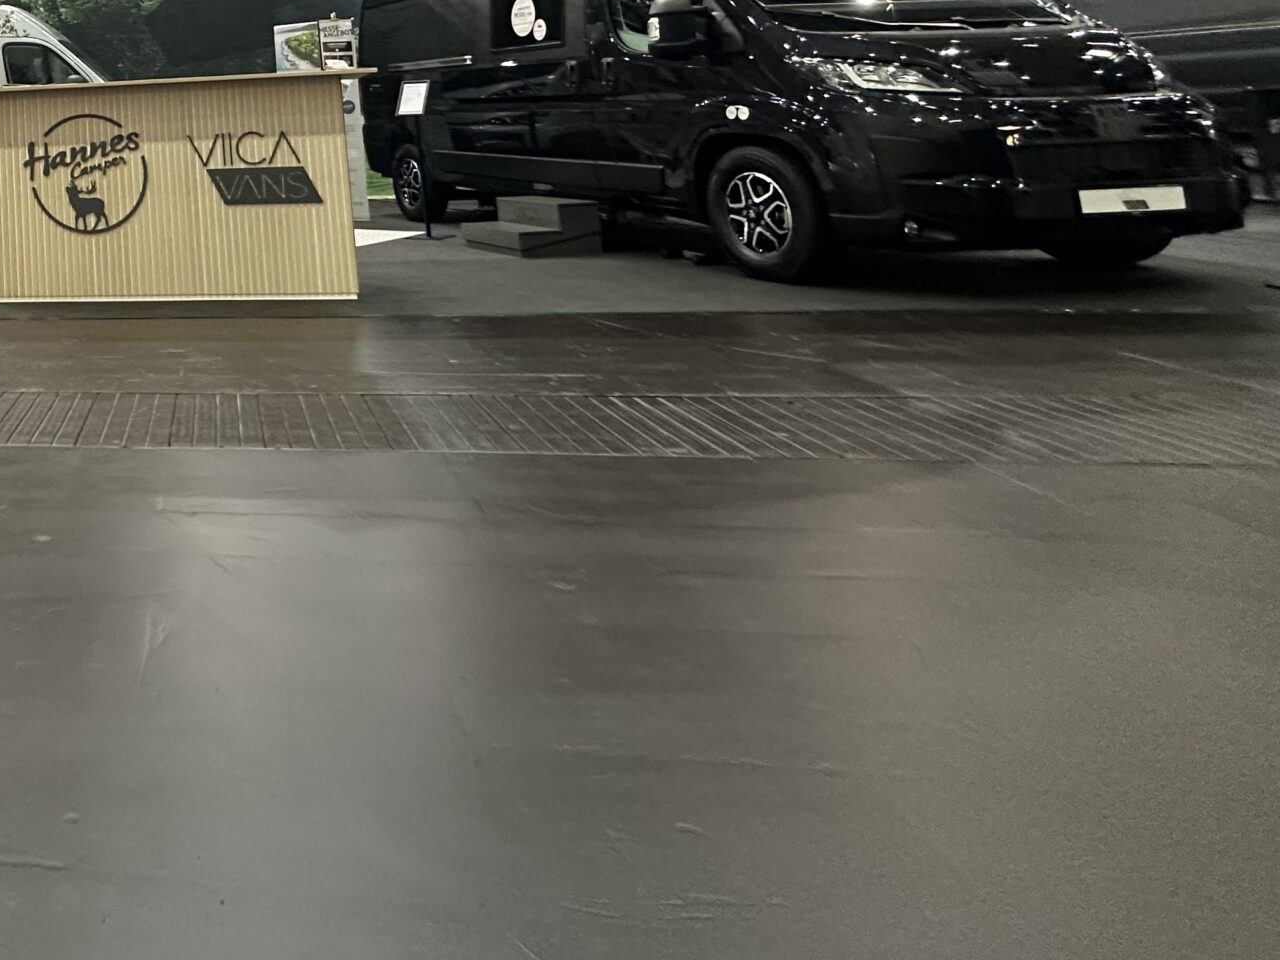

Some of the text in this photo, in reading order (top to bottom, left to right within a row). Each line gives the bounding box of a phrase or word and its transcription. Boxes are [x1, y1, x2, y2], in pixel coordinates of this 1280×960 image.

[23, 131, 140, 182] Hannes
[187, 130, 302, 168] VIICA
[70, 155, 127, 181] Camper
[214, 171, 309, 201] VANS
